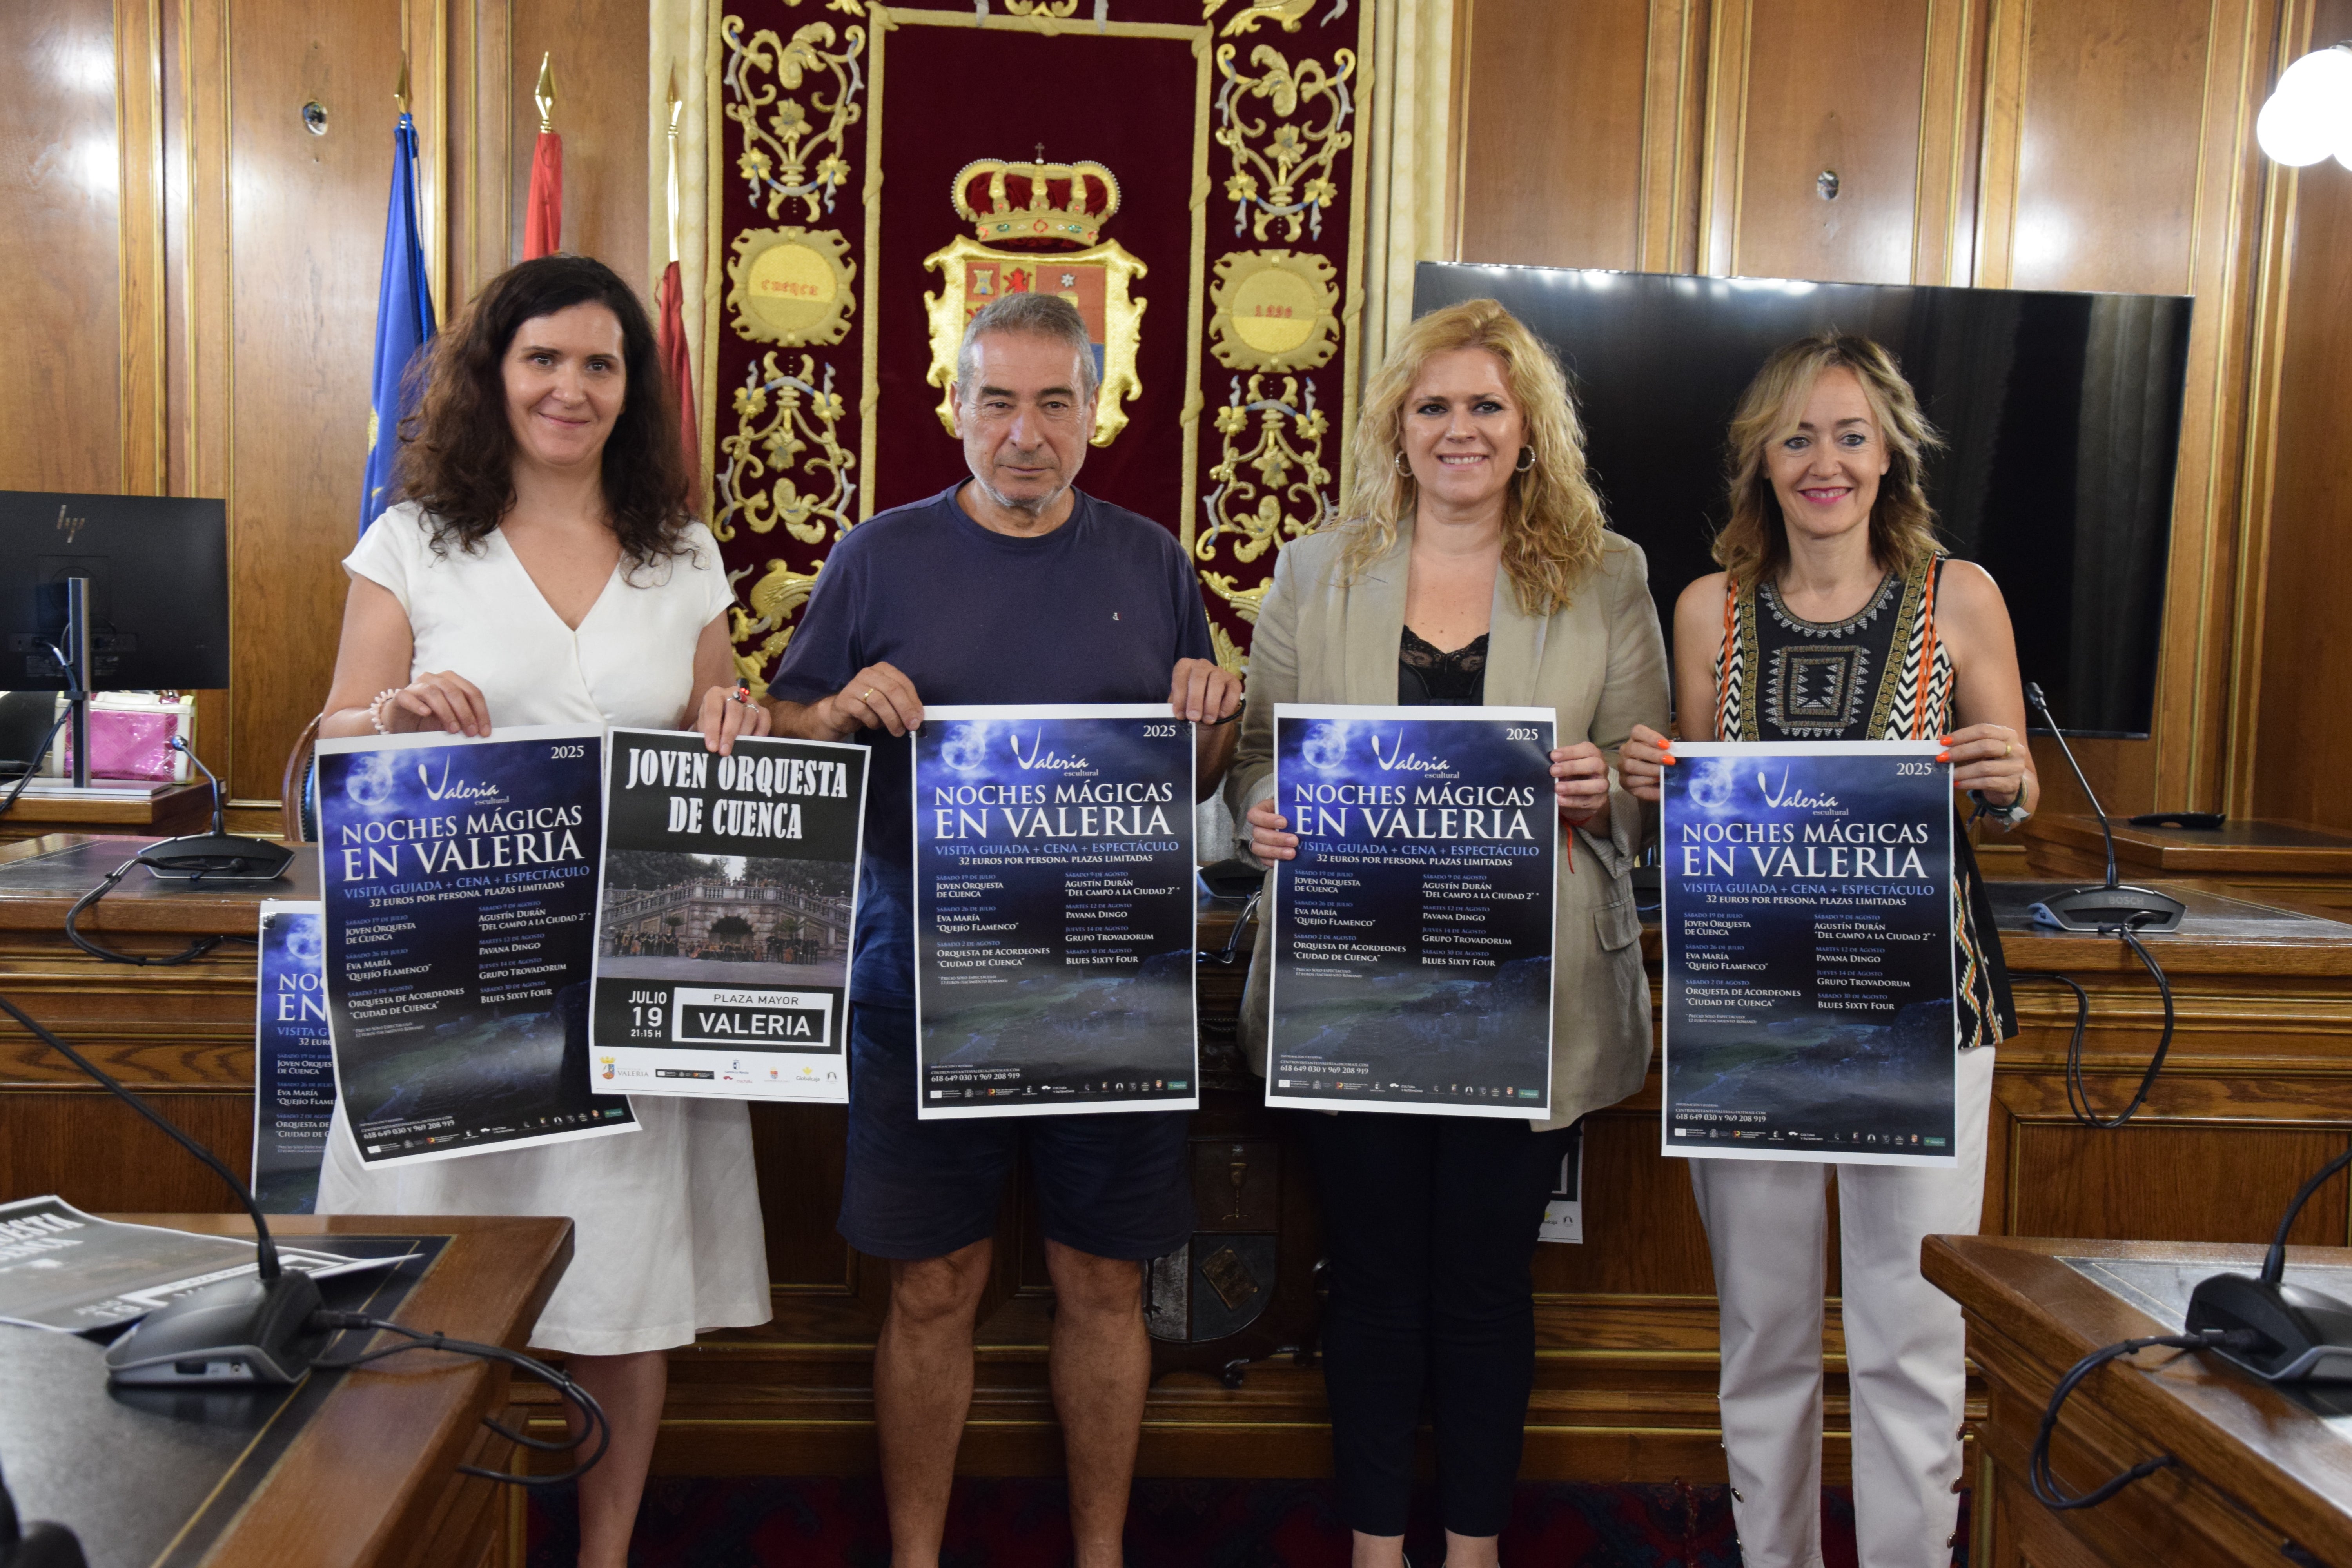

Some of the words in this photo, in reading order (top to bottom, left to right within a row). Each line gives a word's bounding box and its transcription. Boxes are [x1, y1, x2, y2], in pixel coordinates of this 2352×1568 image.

[56, 505, 85, 543] hp
[1143, 724, 1176, 737] 2025
[1506, 728, 1538, 740] 2025
[551, 745, 584, 759] 2025
[1010, 726, 1089, 769] Valeria
[1372, 727, 1450, 771] Valeria
[626, 748, 709, 789] JOVEN
[718, 755, 847, 797] ORQUESTA
[1063, 768, 1099, 777] escultural
[1424, 769, 1460, 778] escultural
[1896, 762, 1932, 775] 2025
[418, 753, 499, 801] Valeria
[935, 784, 1046, 806] NOCHES
[1054, 779, 1172, 803] MÁGICAS
[1758, 763, 1838, 808] Valeria
[1295, 784, 1406, 805] NOCHES
[1414, 781, 1534, 806] MÁGICAS
[668, 796, 703, 833] DE
[713, 799, 802, 839] CUENCA
[1812, 807, 1849, 815] escultural
[343, 816, 457, 845] NOCHES
[465, 805, 582, 835] MÁGICAS
[933, 808, 989, 839] EN
[1000, 804, 1174, 838] VALERIA
[1294, 805, 1348, 836] EN
[1359, 808, 1535, 839] VALERIA
[1683, 822, 1795, 843] NOCHES
[1802, 818, 1928, 843] MÁGICAS
[935, 845, 976, 855] VISITA
[979, 844, 1030, 855] GUIADA
[1043, 843, 1078, 853] CENA
[1092, 839, 1179, 852] ESPECTÁCULO
[1337, 843, 1387, 854] GUIADA
[1401, 845, 1436, 855] CENA
[1451, 843, 1539, 856] ESPECTÁCULO
[341, 845, 399, 881] EN
[410, 829, 584, 874] VALERIA
[958, 857, 970, 865] 32
[1316, 853, 1327, 862] 32
[1681, 846, 1736, 876] EN
[1747, 846, 1929, 878] VALERIA
[344, 886, 387, 898] VISITA
[390, 880, 442, 894] GUIADA
[456, 876, 491, 887] CENA
[505, 866, 590, 883] ESPECTÁCULO
[1683, 883, 1723, 893] VISITA
[1726, 883, 1777, 893] GUIADA
[1791, 884, 1827, 894] CENA
[1842, 882, 1935, 895] ESPECTÁCULO
[369, 898, 381, 907] 32
[383, 896, 414, 906] EUROS
[417, 894, 436, 902] POR
[438, 889, 482, 900] PERSONA.
[484, 886, 515, 896] PLAZAS
[518, 880, 565, 892] LIMITADAS
[1706, 895, 1717, 903] 32
[2109, 896, 2145, 905] BOSCH
[1684, 919, 1708, 929] JOVEN
[1710, 920, 1751, 929] ORQUESTA
[1854, 922, 1885, 930] DURÁN
[1849, 978, 1910, 987] TROVADORUM
[628, 991, 667, 1004] JULIO
[1685, 987, 1729, 996] ORQUESTA
[1744, 988, 1801, 996] ACORDEONES
[714, 994, 753, 1003] PLAZA
[758, 996, 799, 1005] MAYOR
[277, 994, 327, 1022] EN
[633, 1006, 662, 1027] 19
[699, 1012, 811, 1036] VALERIA
[278, 1027, 315, 1036] VISITA
[631, 1029, 653, 1037] 21:15
